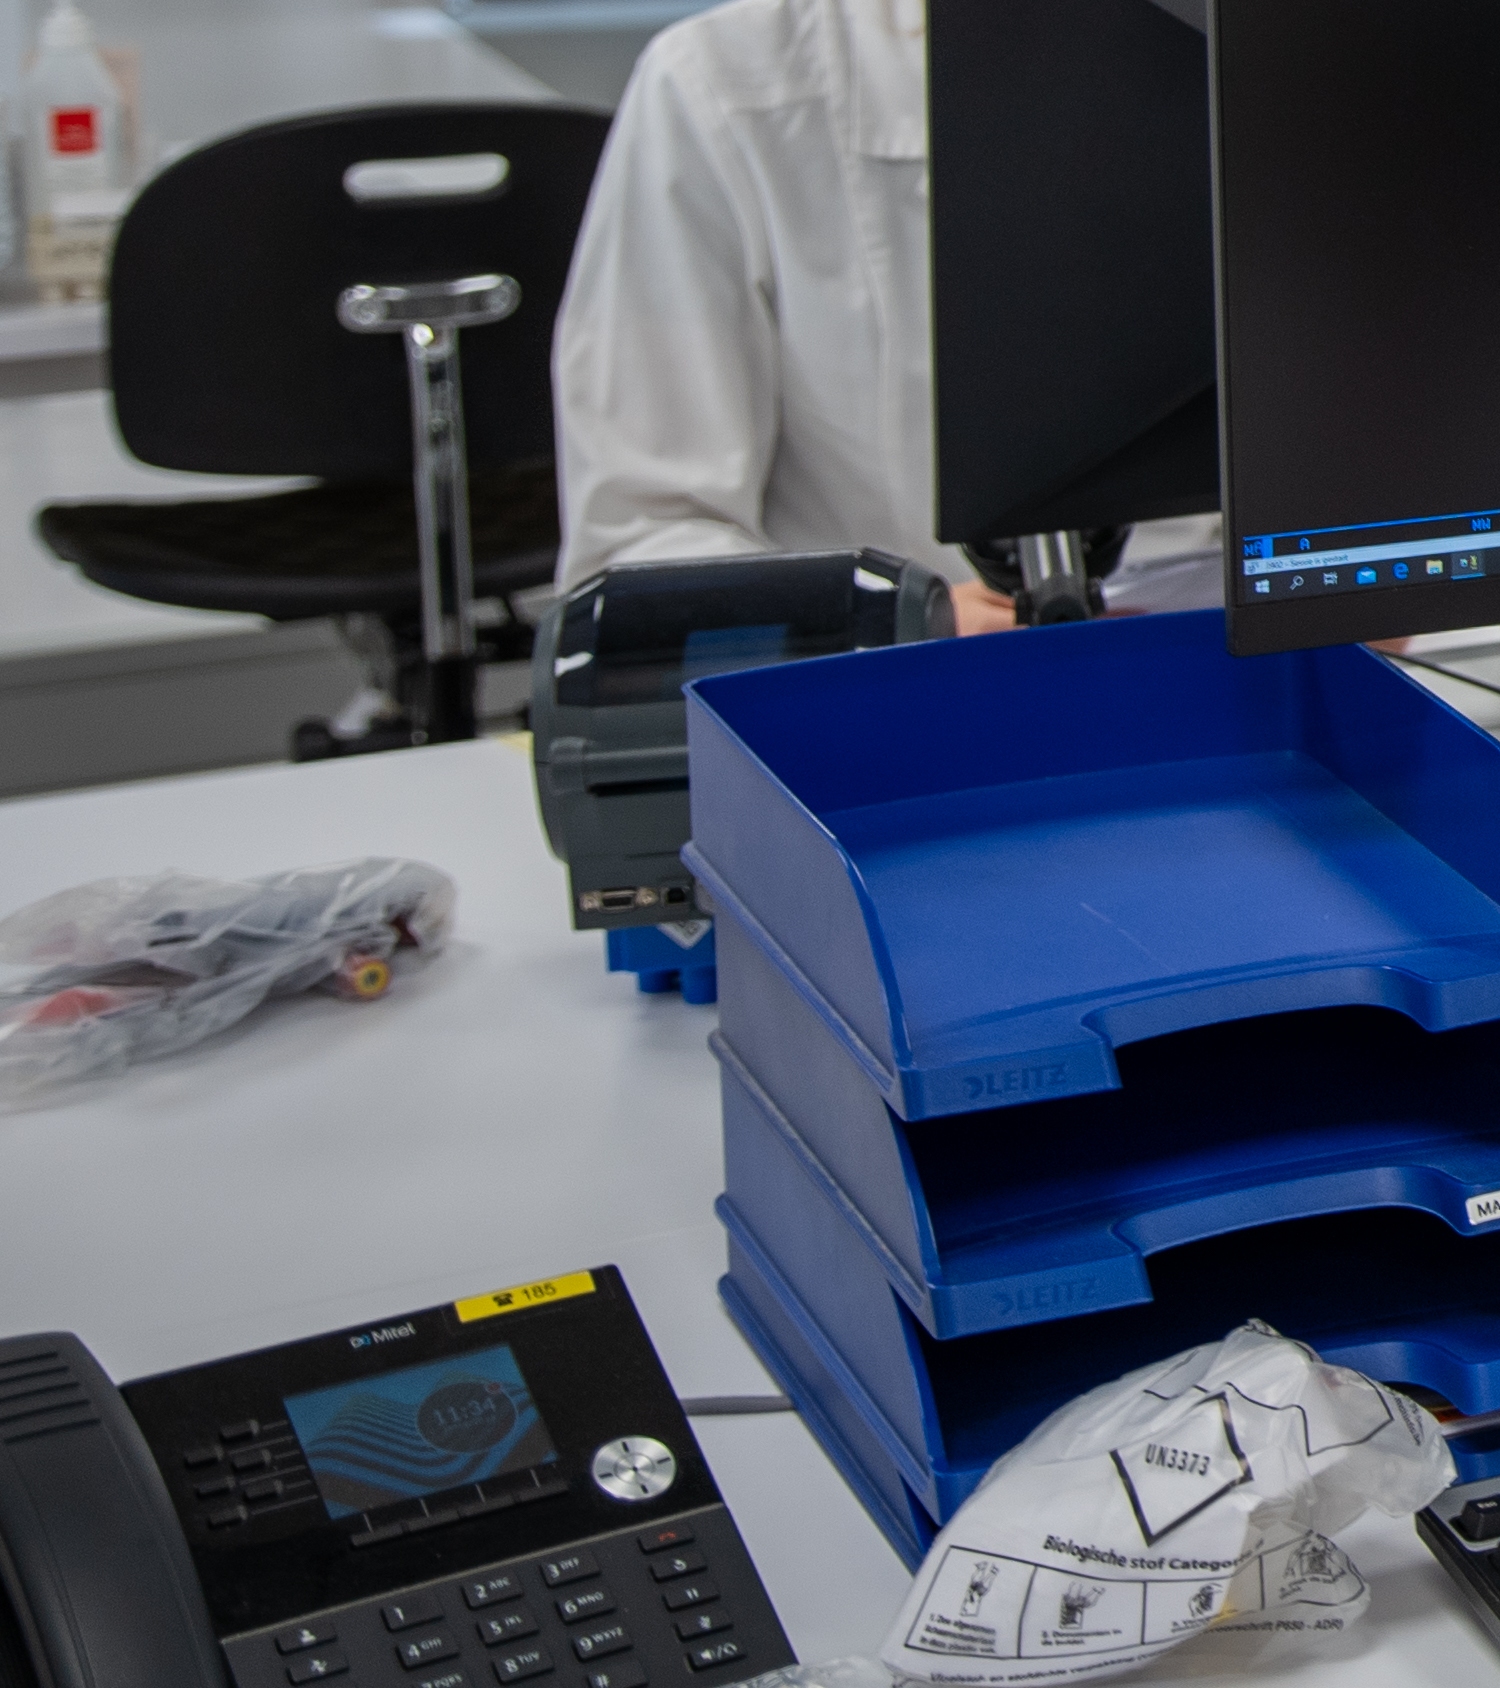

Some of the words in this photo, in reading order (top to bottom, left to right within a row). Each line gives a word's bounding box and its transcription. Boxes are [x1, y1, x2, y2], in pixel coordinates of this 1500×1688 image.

[986, 1062, 1067, 1097] LEITZ
[521, 1282, 557, 1303] 185
[1011, 1278, 1097, 1312] LEITZ
[371, 1321, 417, 1345] Mitel
[1145, 1442, 1210, 1477] UN3373
[1041, 1534, 1127, 1569] Biologische
[1130, 1556, 1165, 1570] stof
[548, 1563, 560, 1579] 3
[473, 1583, 488, 1600] 2
[393, 1606, 406, 1622] 1
[563, 1598, 578, 1614] 6
[490, 1620, 503, 1636] 5
[408, 1643, 422, 1659] 4
[578, 1636, 593, 1652] 9
[504, 1658, 519, 1674] 8
